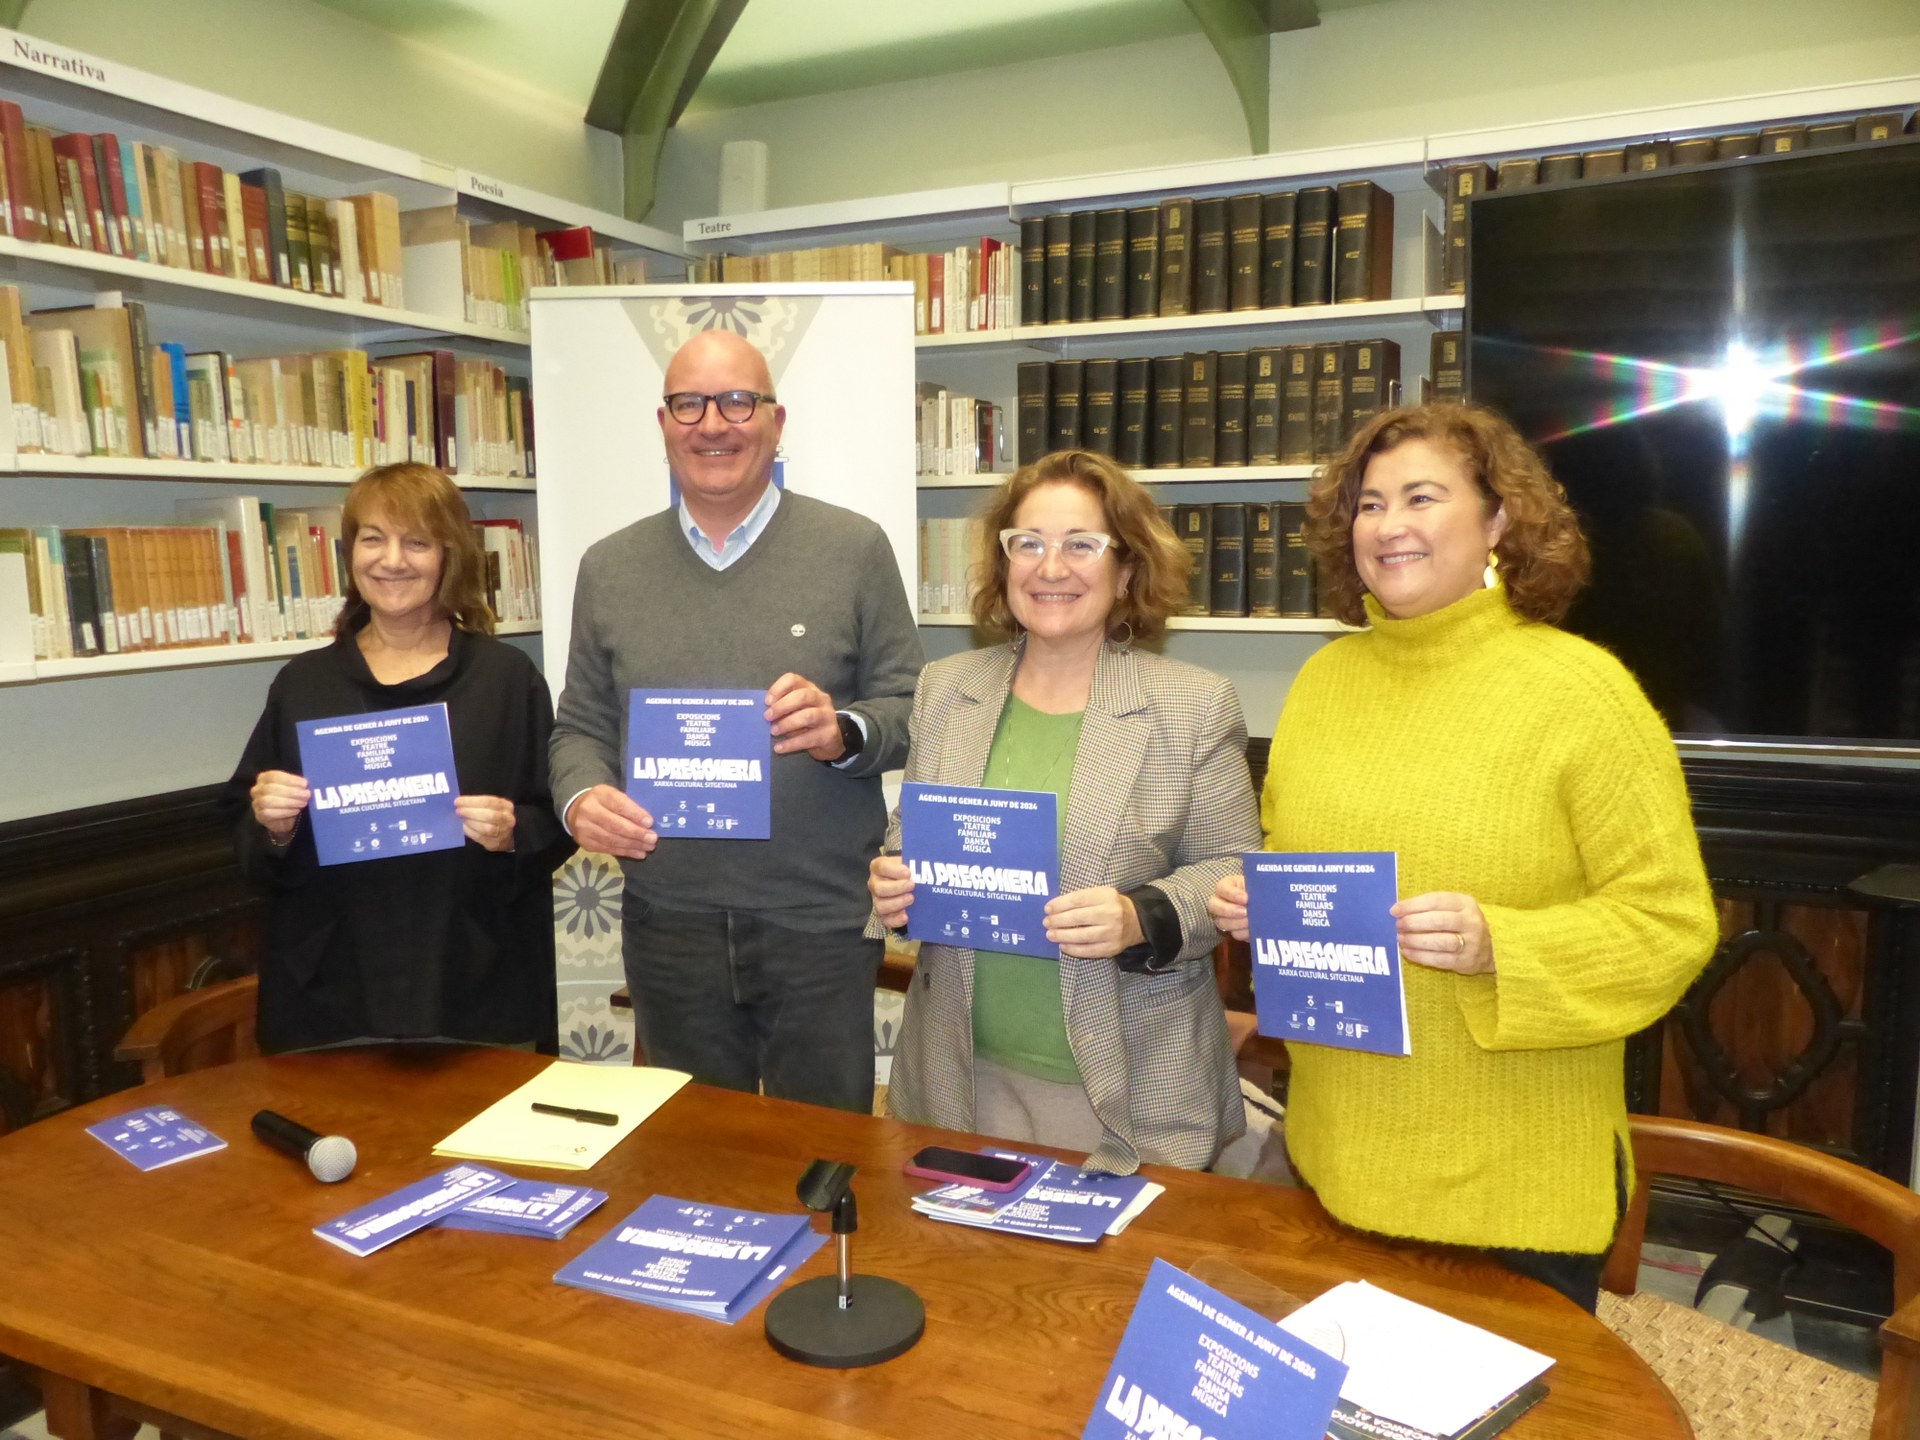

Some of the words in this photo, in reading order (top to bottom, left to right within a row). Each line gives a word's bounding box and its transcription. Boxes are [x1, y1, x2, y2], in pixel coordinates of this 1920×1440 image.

[12, 38, 105, 83] Narrativa
[470, 176, 504, 198] Poesia
[698, 221, 732, 234] Teatre
[313, 726, 343, 736] AGENDA
[343, 724, 353, 732] DE
[353, 721, 377, 730] GENER
[383, 718, 401, 726] JUNY
[402, 716, 411, 724] DE
[412, 714, 429, 723] 2024
[350, 733, 397, 746] EXPOSICIONS
[361, 741, 388, 751] TEATRE
[356, 747, 394, 758] FAMILIARS
[364, 754, 389, 764] DANSA
[633, 757, 657, 778] LA
[313, 785, 341, 810] LA
[339, 806, 360, 814] XARXA
[360, 801, 392, 811] CULTURAL
[392, 797, 426, 807] SITGETANA
[918, 793, 947, 803] AGENDA
[948, 795, 957, 804] DE
[958, 796, 982, 805] GENER
[982, 798, 988, 806] A
[989, 798, 1008, 807] JUNY
[1009, 800, 1018, 808] DE
[1020, 800, 1037, 809] 2024
[952, 813, 1001, 825] EXPOSICIONS
[963, 821, 990, 831] TEATRE
[957, 828, 996, 839] FAMILIARS
[964, 836, 989, 845] DANSA
[909, 858, 934, 885] LA
[1283, 864, 1292, 872] DE
[1292, 864, 1316, 872] GENER
[1317, 864, 1323, 872] A
[1323, 864, 1343, 872] JUNY
[1355, 865, 1375, 873] 2024
[931, 886, 952, 895] XARXA
[953, 887, 985, 898] CULTURAL
[986, 891, 1021, 902] SITGETANA
[1289, 883, 1337, 893] EXPOSICIONS
[1300, 892, 1326, 901] TEATRE
[1295, 900, 1333, 910] FAMILIARS
[1302, 909, 1327, 918] DANSA
[1255, 937, 1280, 965] LA
[1278, 968, 1297, 976] XARXA
[1298, 970, 1328, 979] CULTURAL
[1329, 973, 1364, 983] SITGETANA
[1166, 1284, 1203, 1312] AGENDA
[1202, 1304, 1217, 1320] DE
[1215, 1312, 1247, 1338] GENER
[1245, 1330, 1254, 1343] A
[1253, 1335, 1280, 1356] JUNY
[1278, 1349, 1294, 1365] DE
[1291, 1359, 1316, 1380] 2024
[1198, 1333, 1260, 1379] EXPOSICIONS
[1207, 1352, 1242, 1382] TEATRE
[1194, 1359, 1244, 1398] FAMILIARS
[1198, 1376, 1230, 1404] DANSA
[1105, 1374, 1142, 1428] LA
